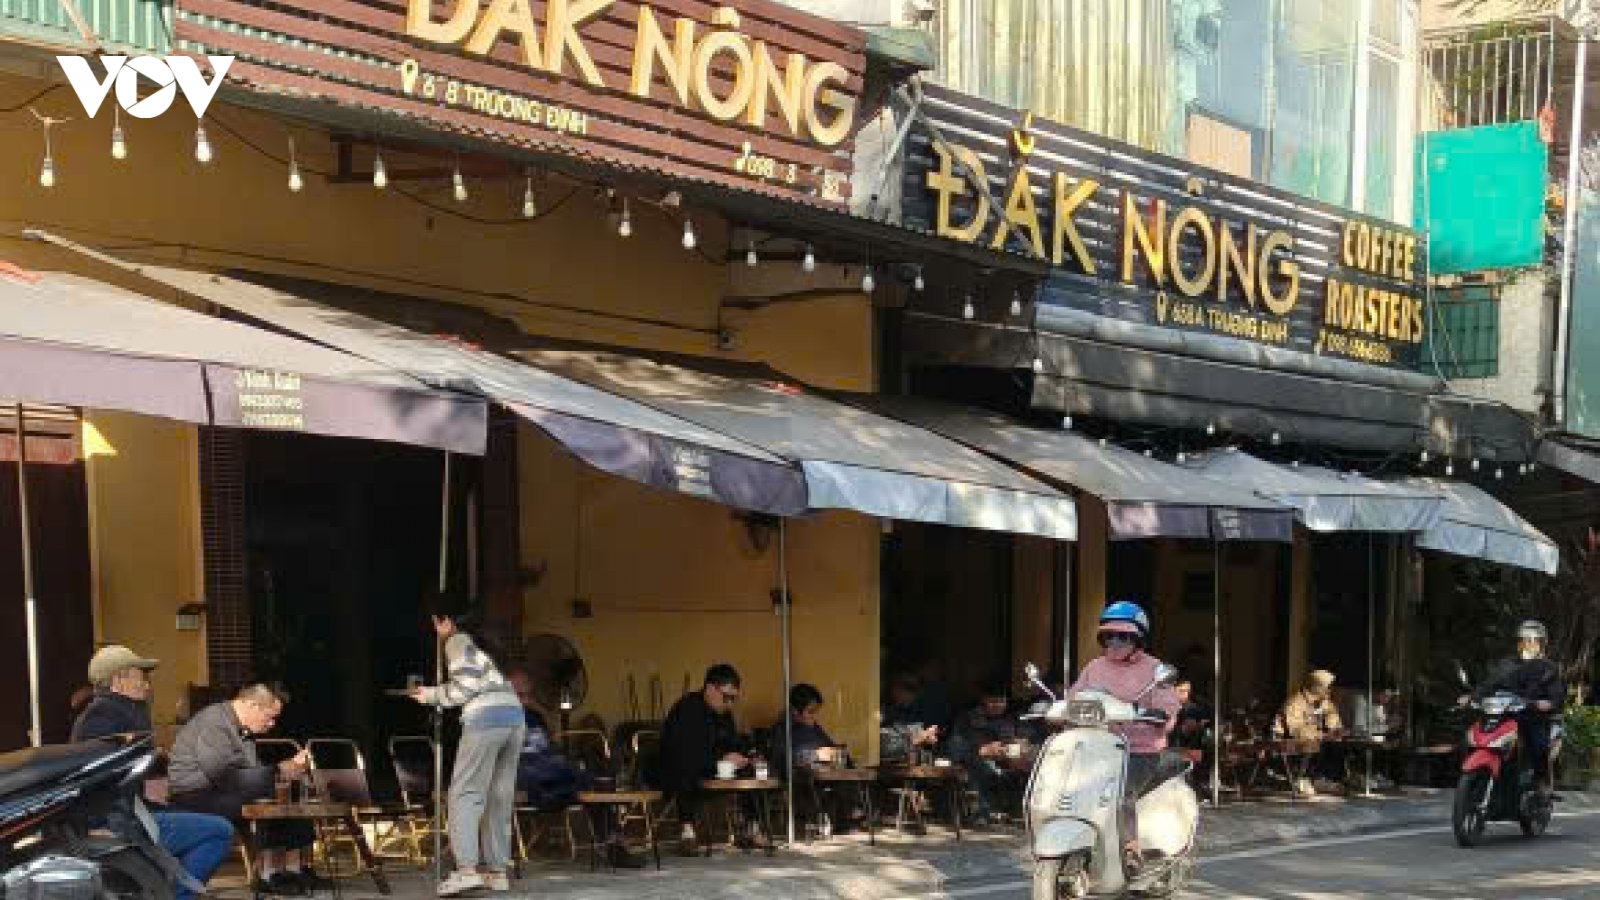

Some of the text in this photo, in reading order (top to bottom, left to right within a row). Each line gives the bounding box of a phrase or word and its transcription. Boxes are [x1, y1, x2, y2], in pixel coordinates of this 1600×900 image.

[631, 6, 858, 146] NÔNG
[925, 112, 1299, 315] ĐẮK NÔNG
[1343, 220, 1415, 281] COFFEE
[1325, 278, 1422, 344] ROASTERS
